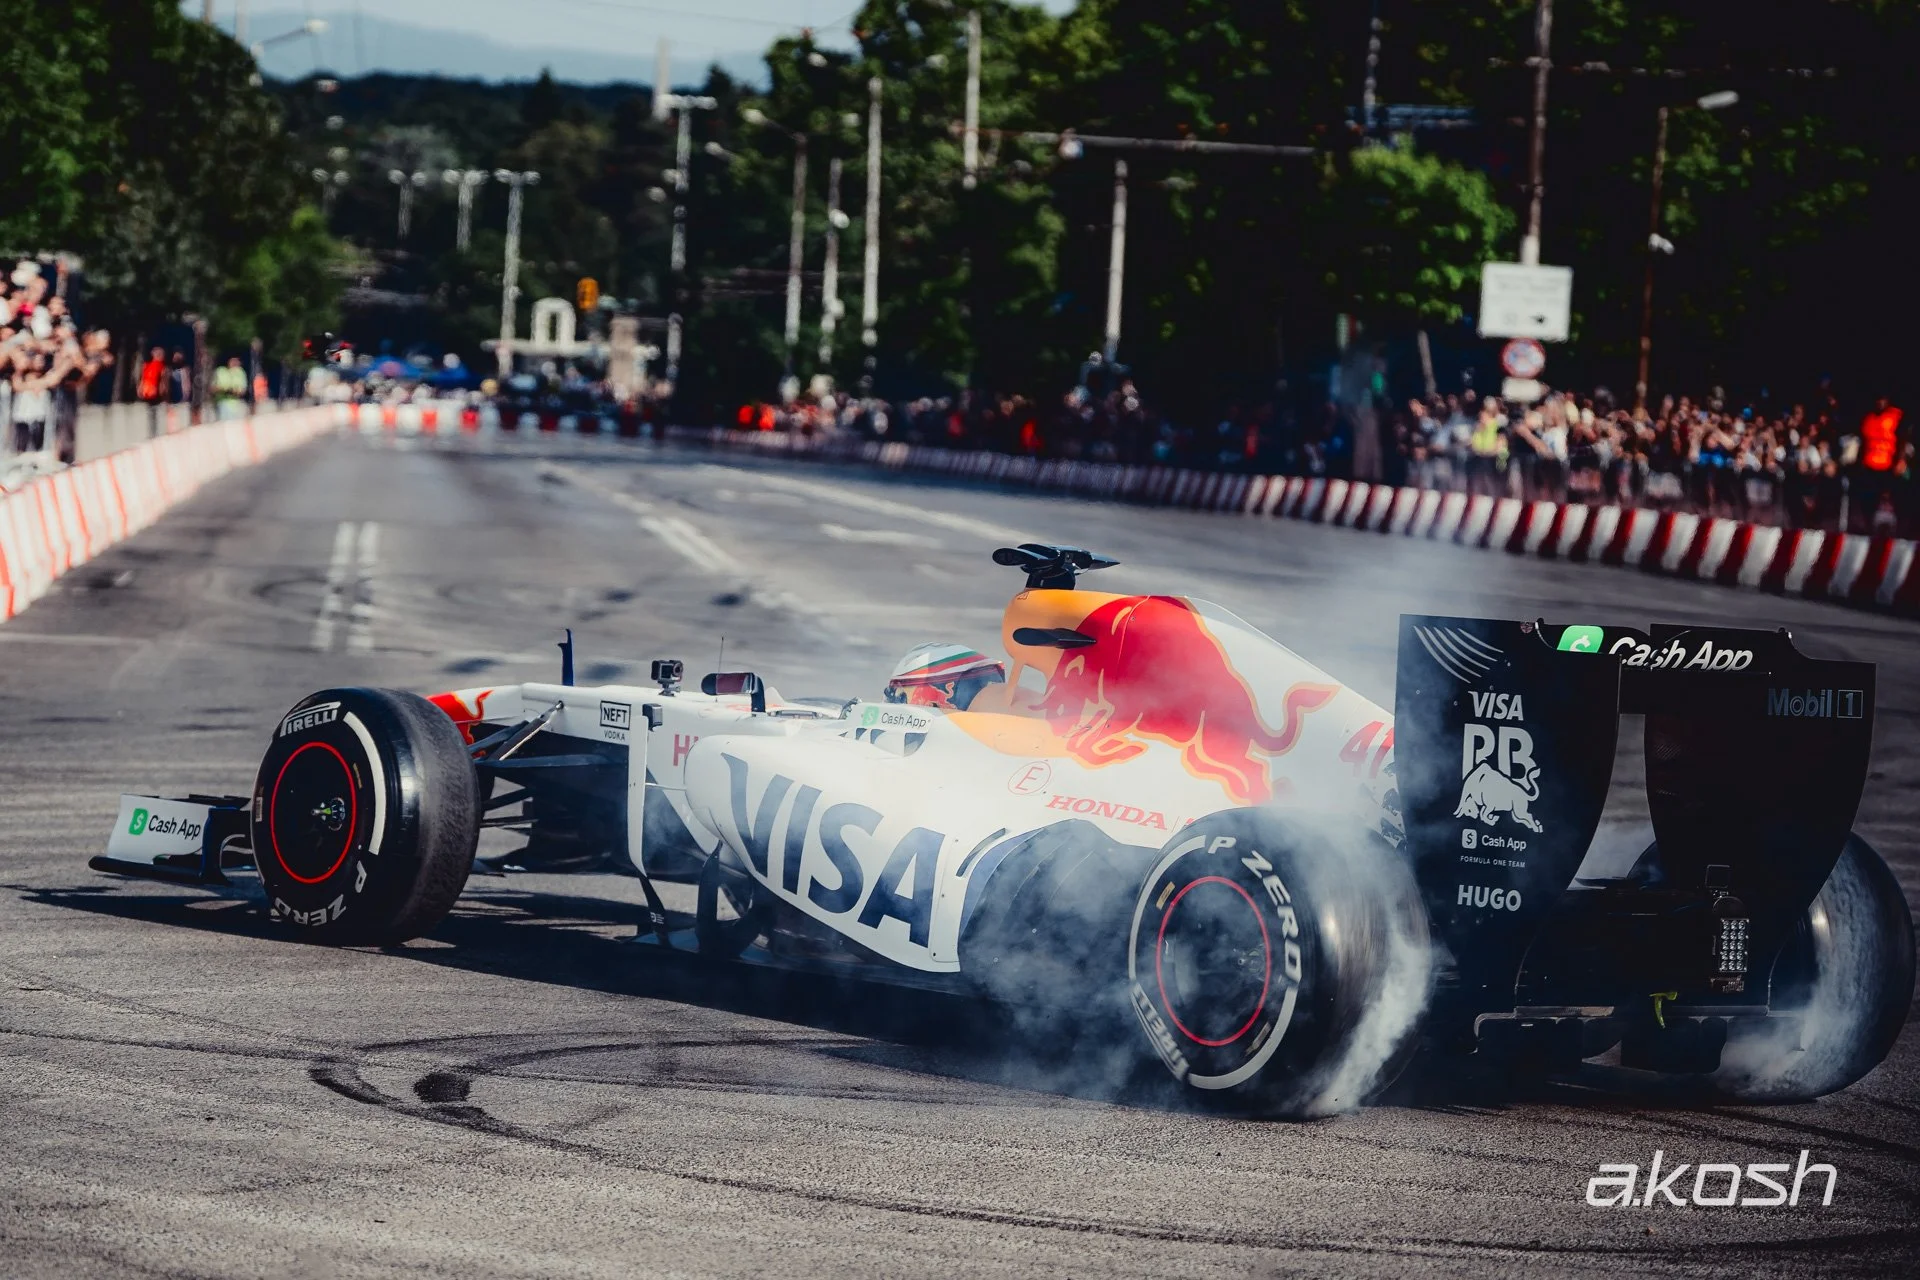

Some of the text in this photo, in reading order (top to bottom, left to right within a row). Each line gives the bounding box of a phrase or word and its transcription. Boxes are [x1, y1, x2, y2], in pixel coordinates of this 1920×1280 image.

[603, 707, 627, 723] NEFT
[1468, 691, 1524, 721] VISA
[1767, 688, 1833, 717] Mobil
[280, 701, 341, 737] PIRELLI
[881, 712, 905, 727] Cash
[905, 715, 927, 729] App
[604, 729, 626, 741] VODKA
[1045, 794, 1168, 831] HONDA
[148, 814, 177, 834] Cash
[177, 818, 201, 840] App
[721, 753, 945, 948] VISA
[1481, 834, 1505, 848] Cash
[1506, 837, 1527, 852] App
[1460, 855, 1526, 868] FORMULA ONE TEAM
[274, 860, 367, 927] P ZERO
[1457, 884, 1522, 912] HUGO
[1208, 836, 1236, 854] P
[1241, 850, 1302, 983] ZERO
